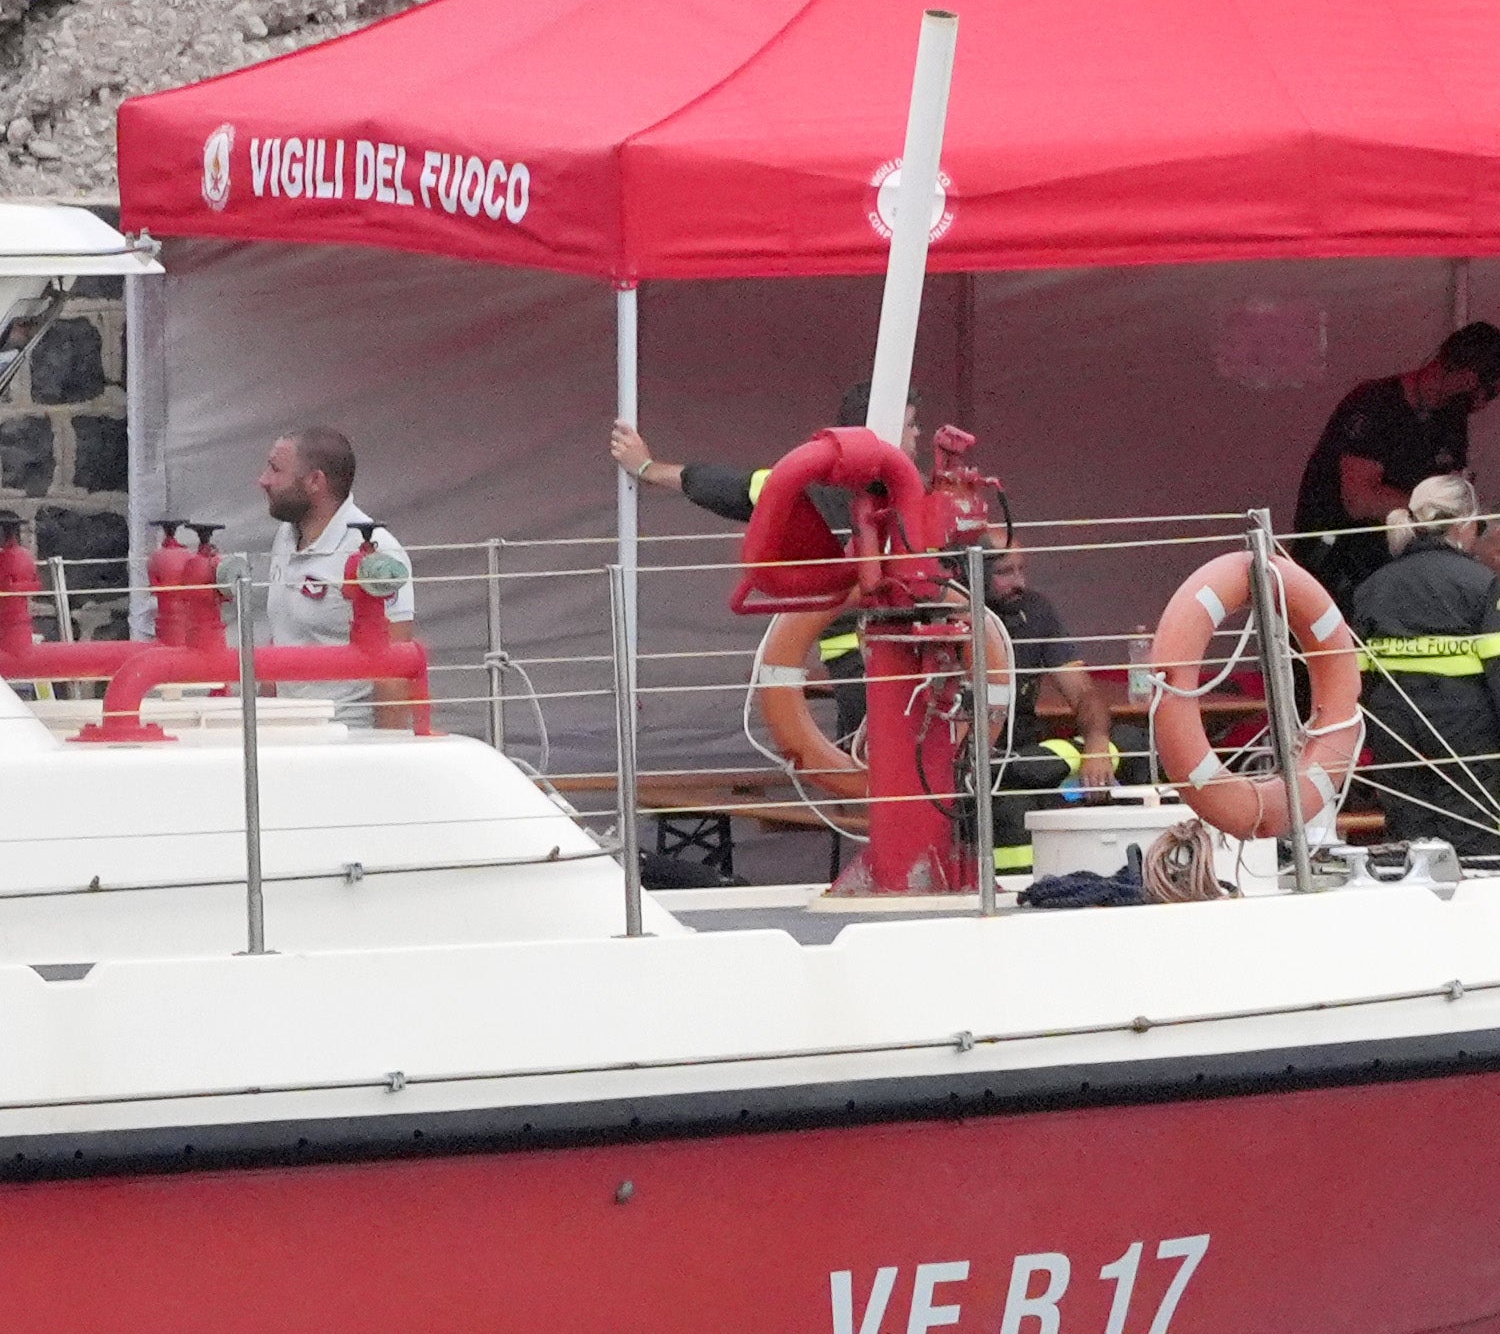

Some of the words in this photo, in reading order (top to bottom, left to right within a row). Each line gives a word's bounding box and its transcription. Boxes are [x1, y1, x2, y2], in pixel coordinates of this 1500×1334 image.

[250, 138, 344, 198] VIGILI
[355, 141, 413, 205] DEL
[420, 151, 529, 223] FUOCO
